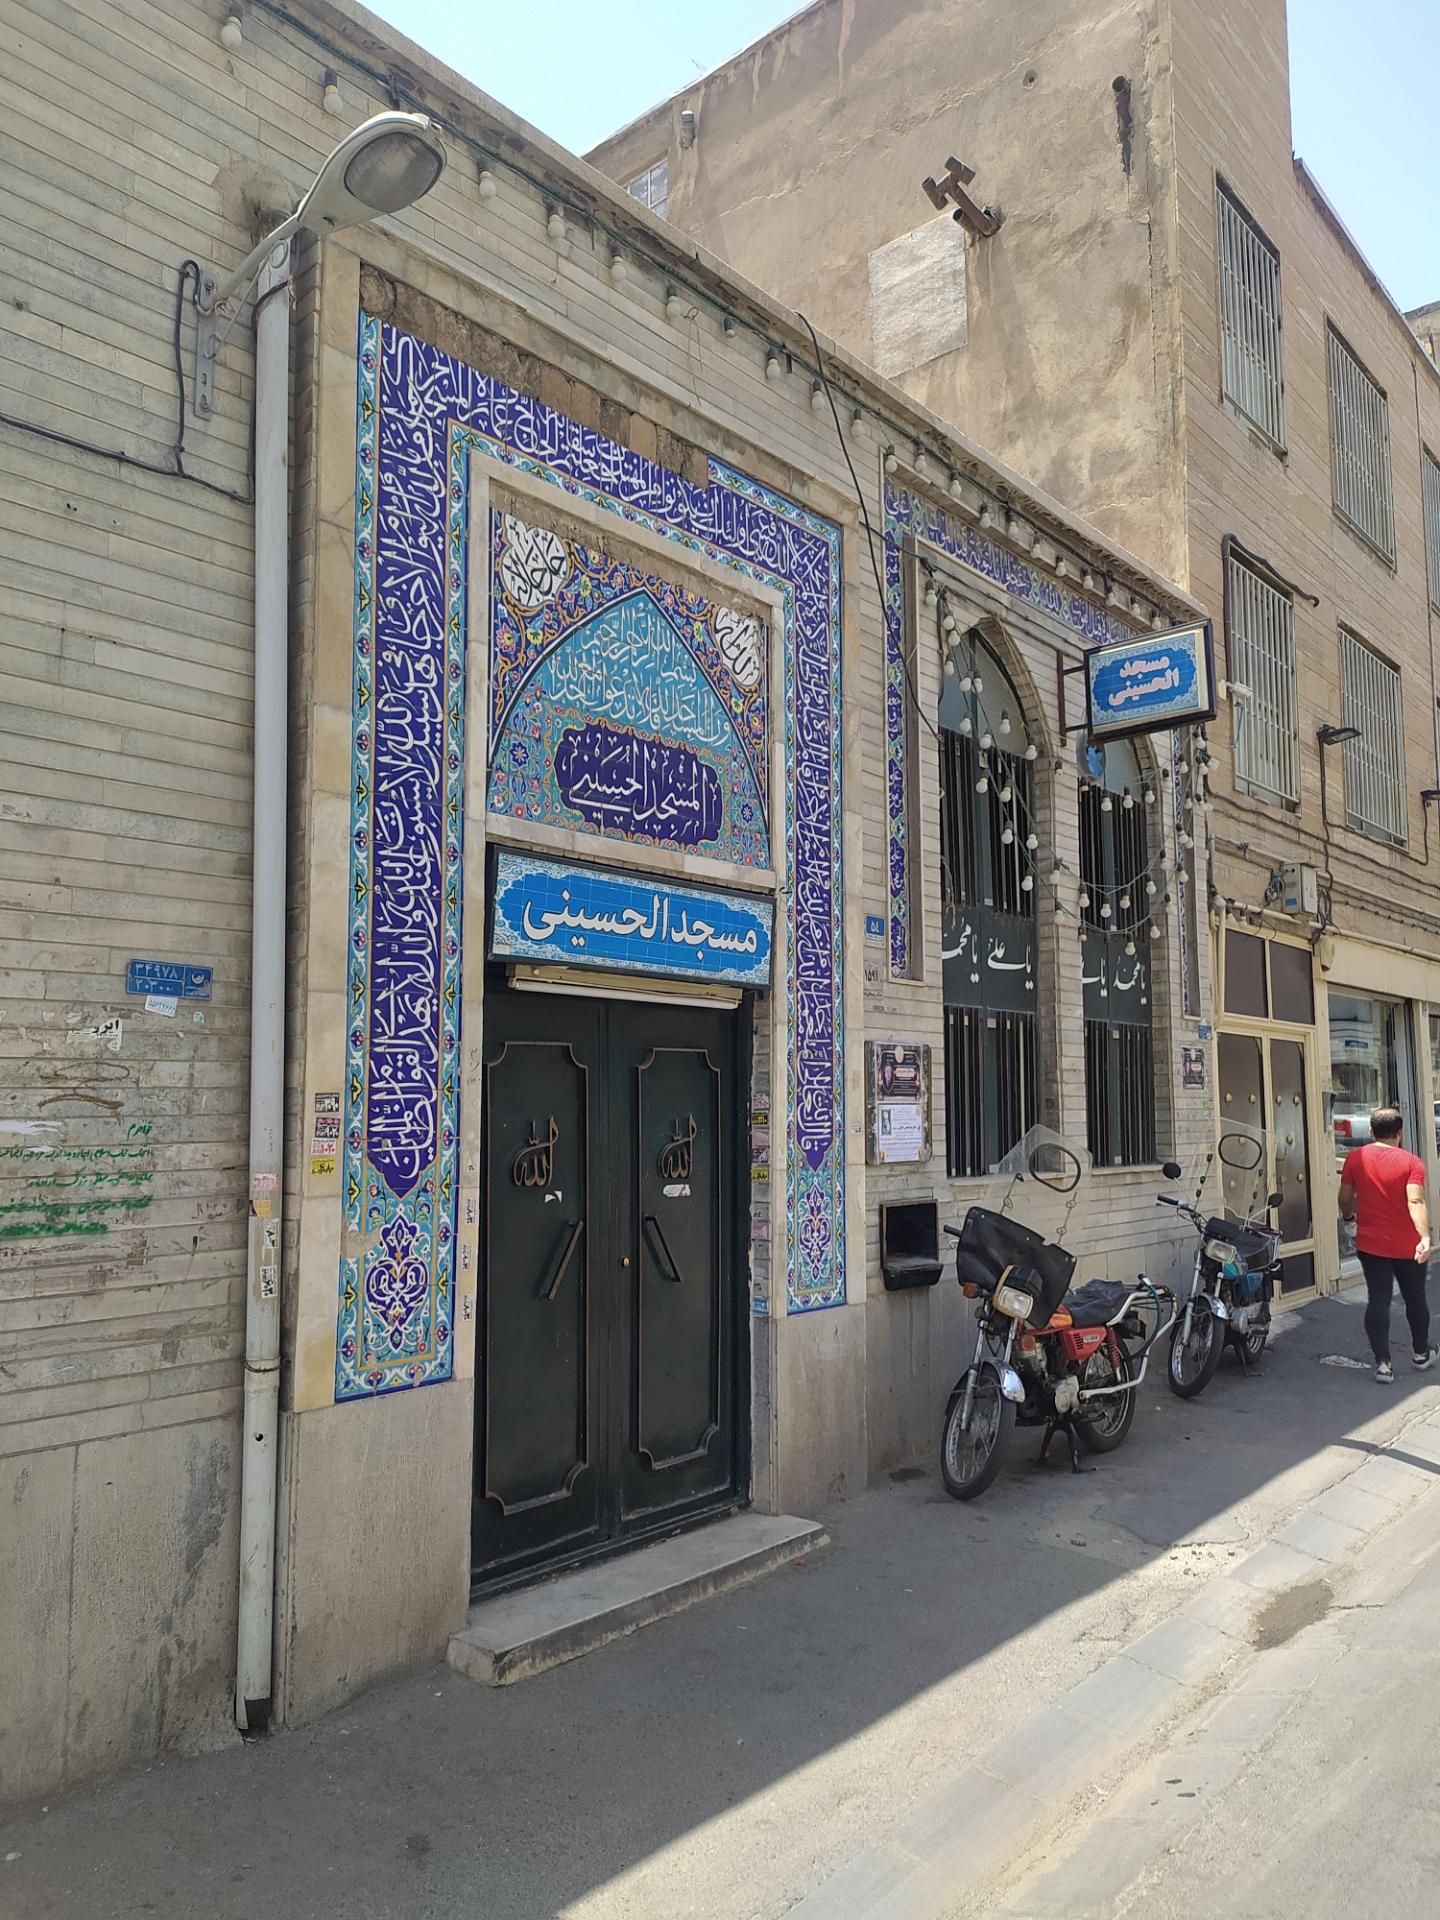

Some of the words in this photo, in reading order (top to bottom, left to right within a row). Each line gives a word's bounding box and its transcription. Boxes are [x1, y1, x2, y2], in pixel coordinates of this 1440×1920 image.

[1119, 655, 1170, 679] مسجد
[671, 909, 760, 961] مسجد
[135, 963, 178, 979] ۳۴۹۷۸
[512, 1113, 560, 1187] الله
[658, 1112, 698, 1179] الله
